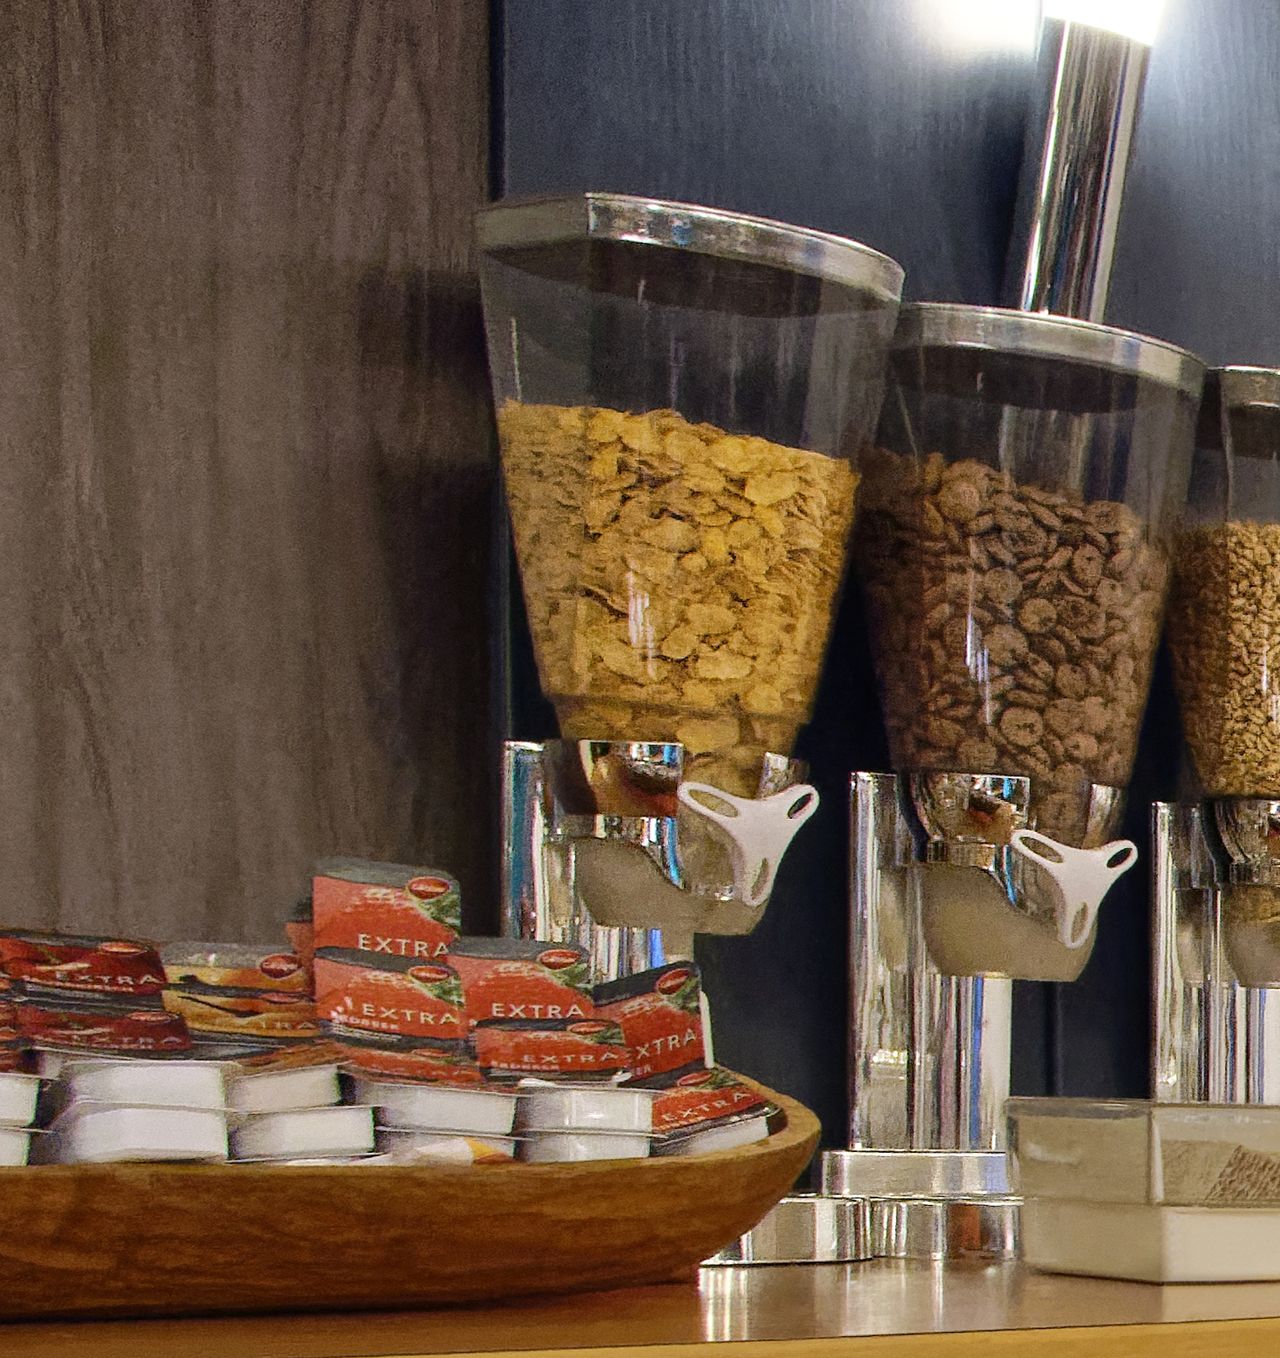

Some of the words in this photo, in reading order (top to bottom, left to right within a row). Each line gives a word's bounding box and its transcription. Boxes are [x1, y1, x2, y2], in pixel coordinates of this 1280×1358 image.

[358, 933, 450, 957] EXTRA
[362, 1003, 461, 1025] EXTRA
[491, 1003, 585, 1019] EXTRA
[634, 1028, 698, 1060] XTRA
[522, 1051, 619, 1064] EXTRA
[662, 1091, 751, 1122] EXTRA
